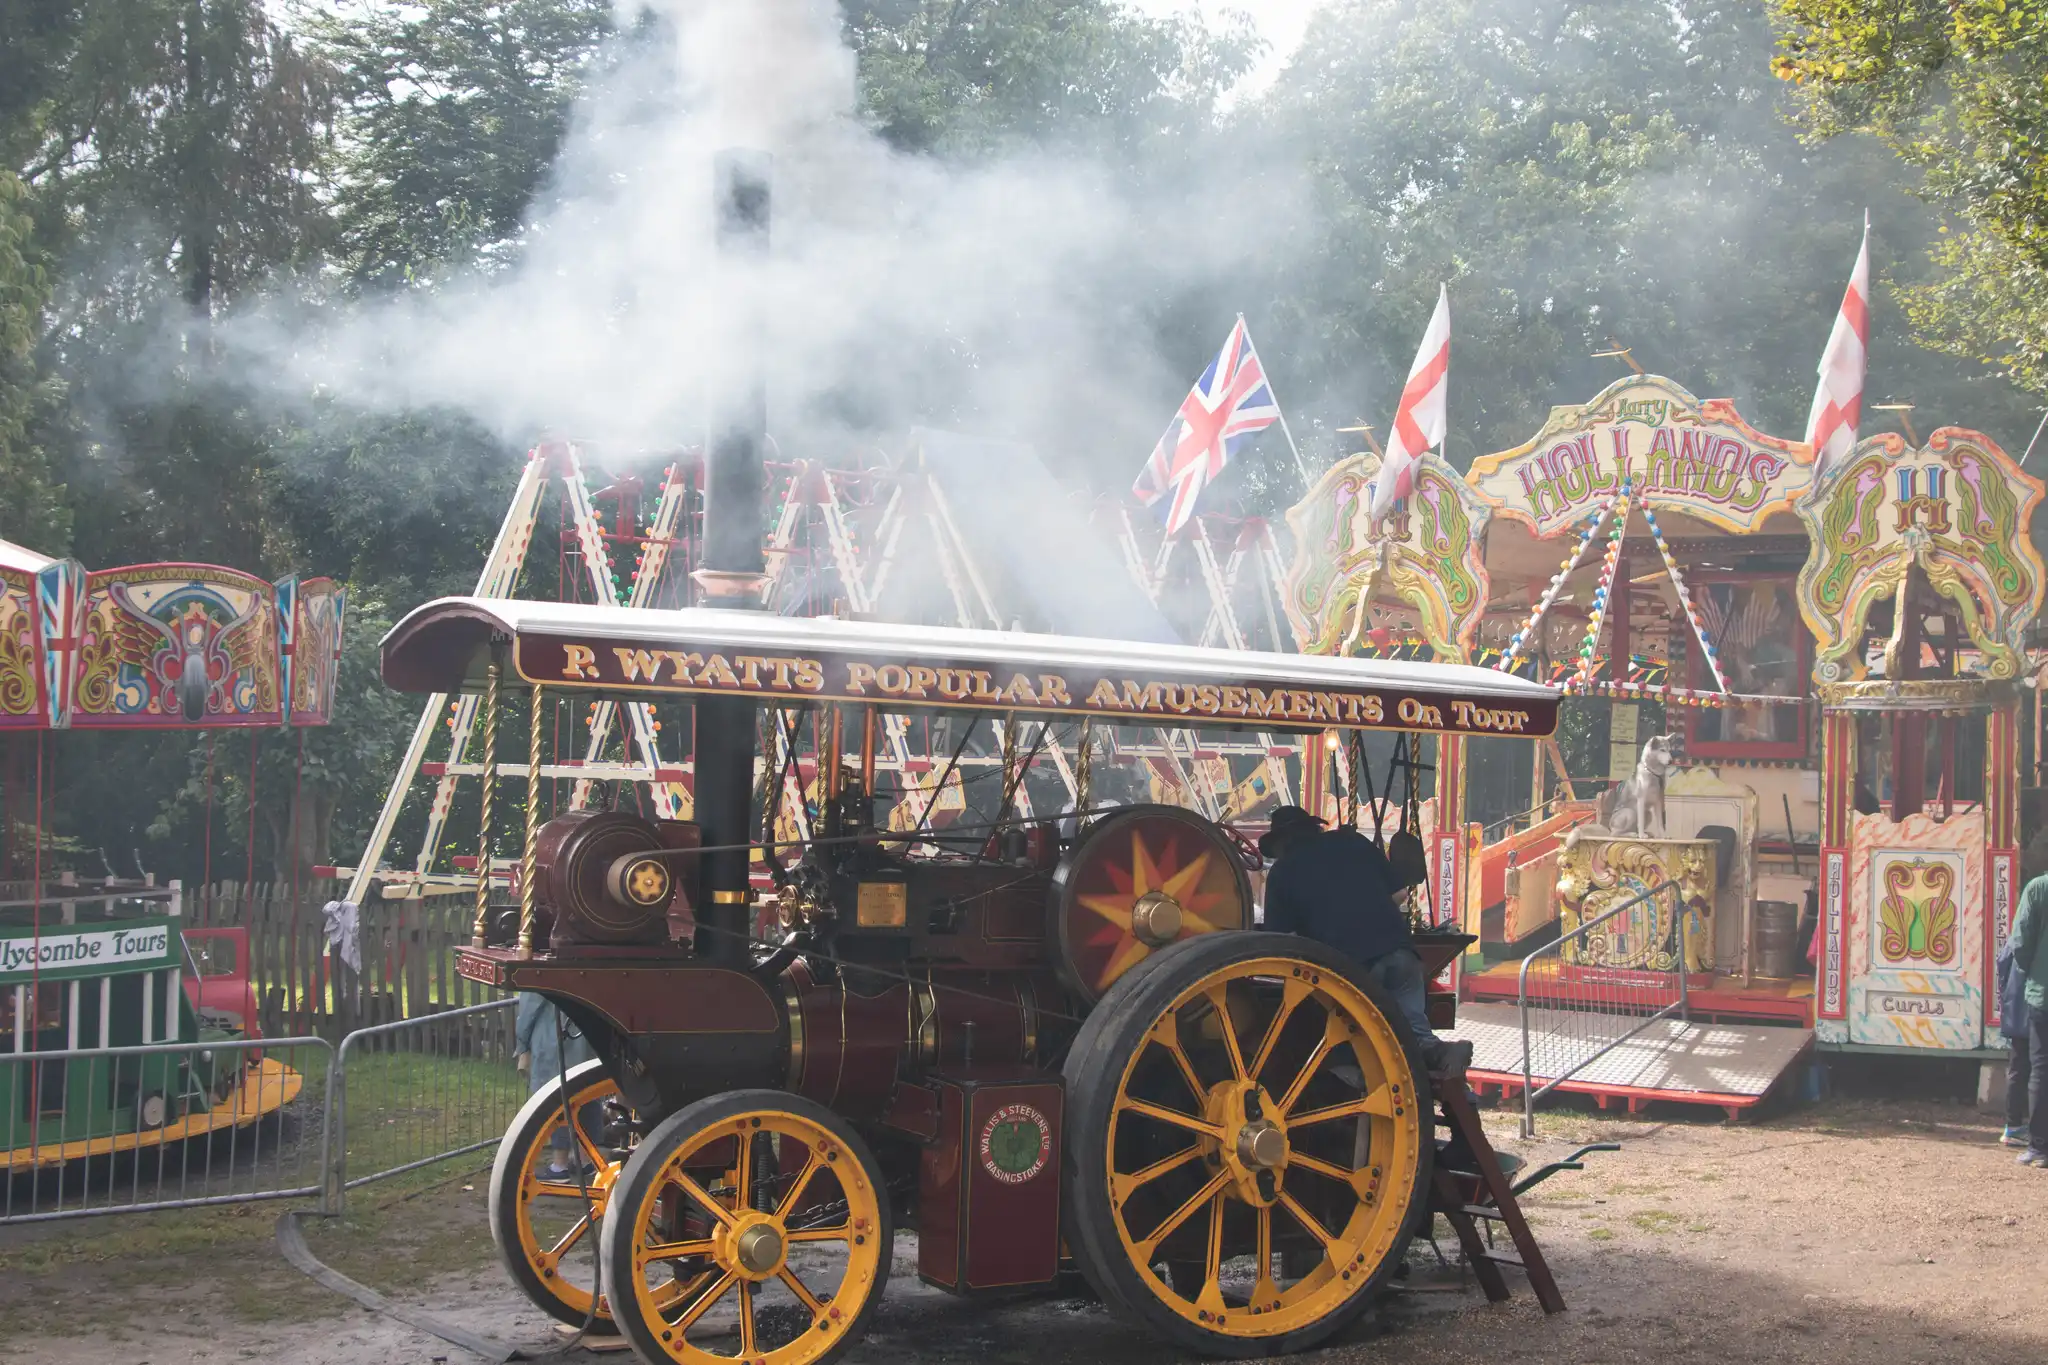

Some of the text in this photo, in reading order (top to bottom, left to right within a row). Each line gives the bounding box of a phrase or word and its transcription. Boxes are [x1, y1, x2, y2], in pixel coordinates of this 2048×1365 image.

[1614, 398, 1669, 427] Harry
[1515, 424, 1789, 522] HOLLANDS
[561, 643, 600, 682] P.
[845, 662, 1070, 704] POPULAR
[1085, 677, 1383, 720] AMUSEMENTS
[1397, 697, 1444, 728] On
[1451, 700, 1530, 732] Tour
[0, 931, 166, 970] lycombe Tours
[1882, 996, 1945, 1016] Curtis
[981, 1115, 999, 1154] WALLIS
[999, 1109, 1008, 1120] &
[1008, 1105, 1048, 1133] STEEVENS
[986, 1159, 1043, 1183] BASINGSTOKE
